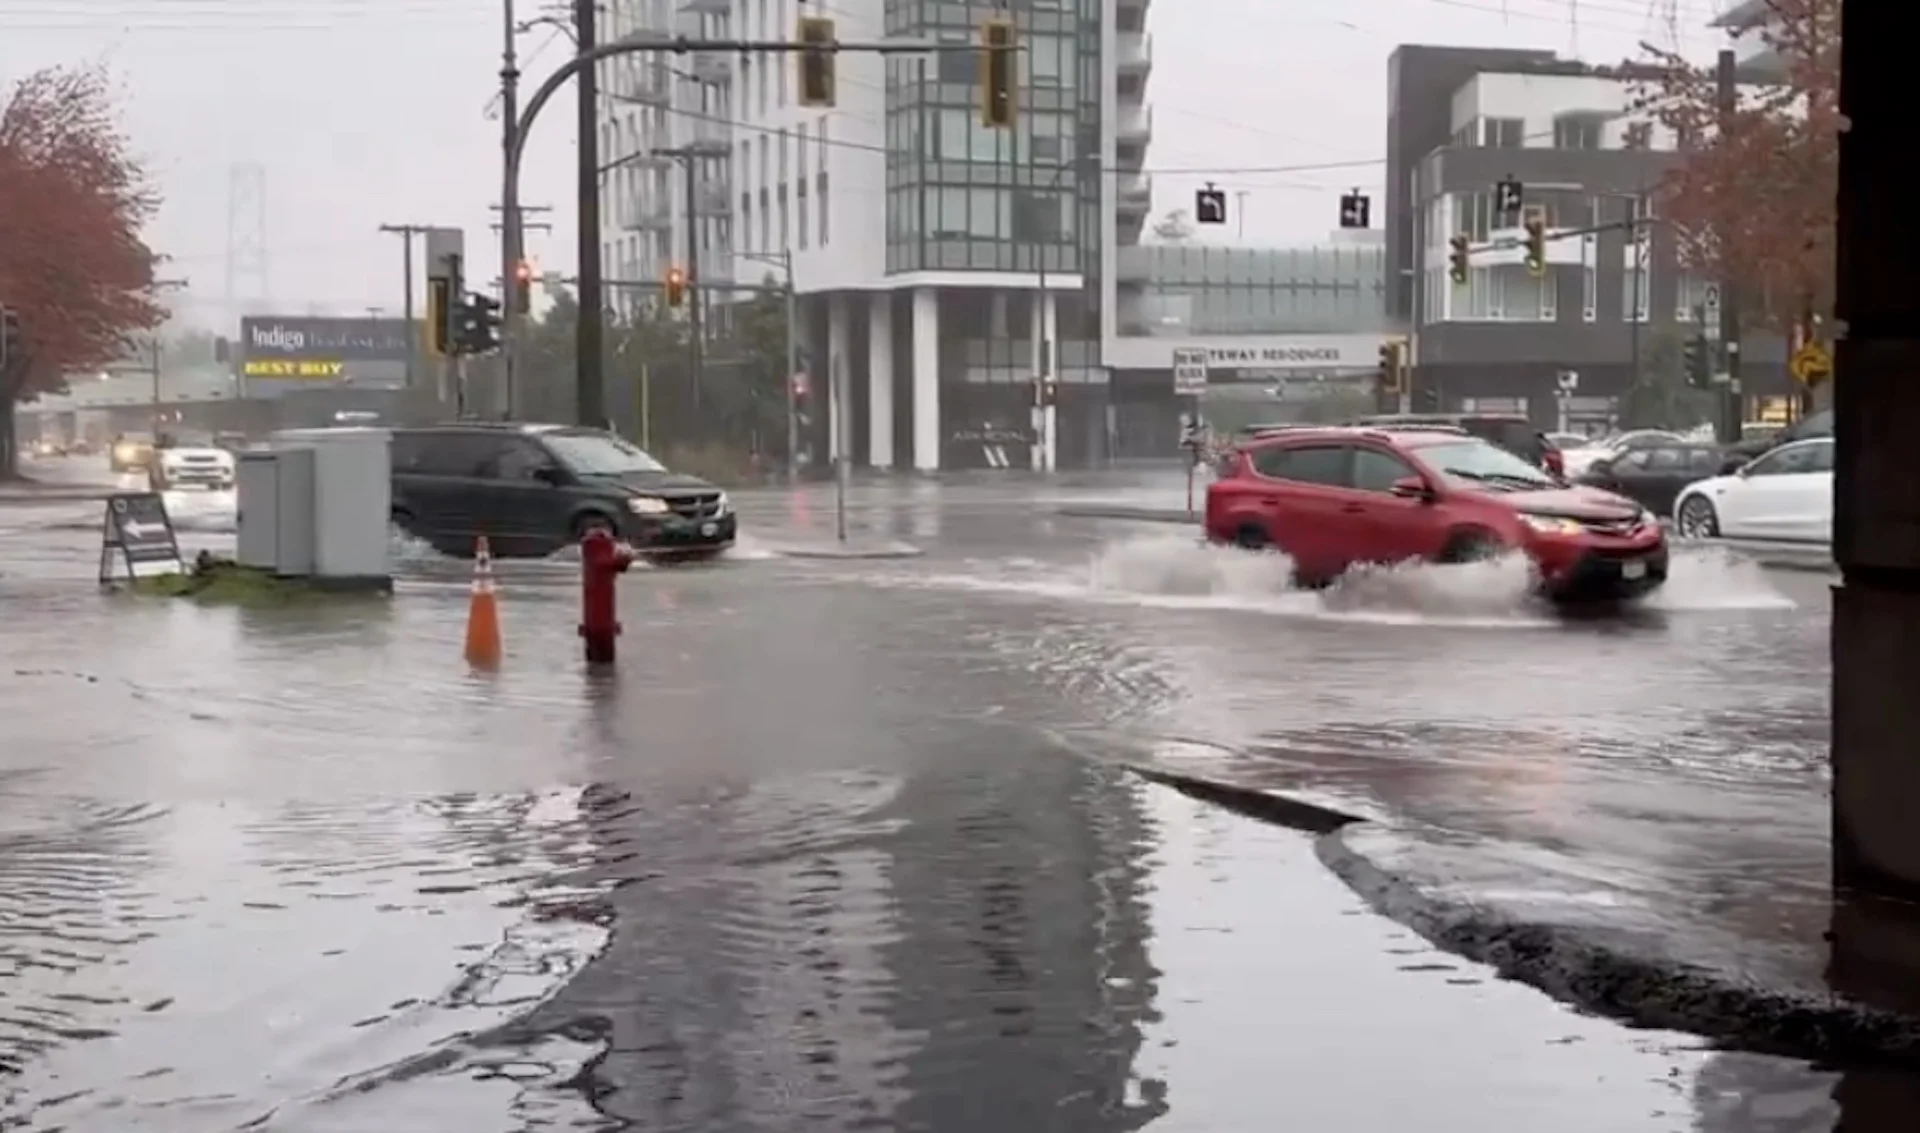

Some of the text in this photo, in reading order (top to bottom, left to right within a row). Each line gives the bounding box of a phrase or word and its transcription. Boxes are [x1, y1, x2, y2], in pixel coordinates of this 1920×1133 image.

[253, 324, 304, 351] Indigo
[1208, 348, 1256, 361] TEWAY
[245, 362, 343, 375] BEST BUY
